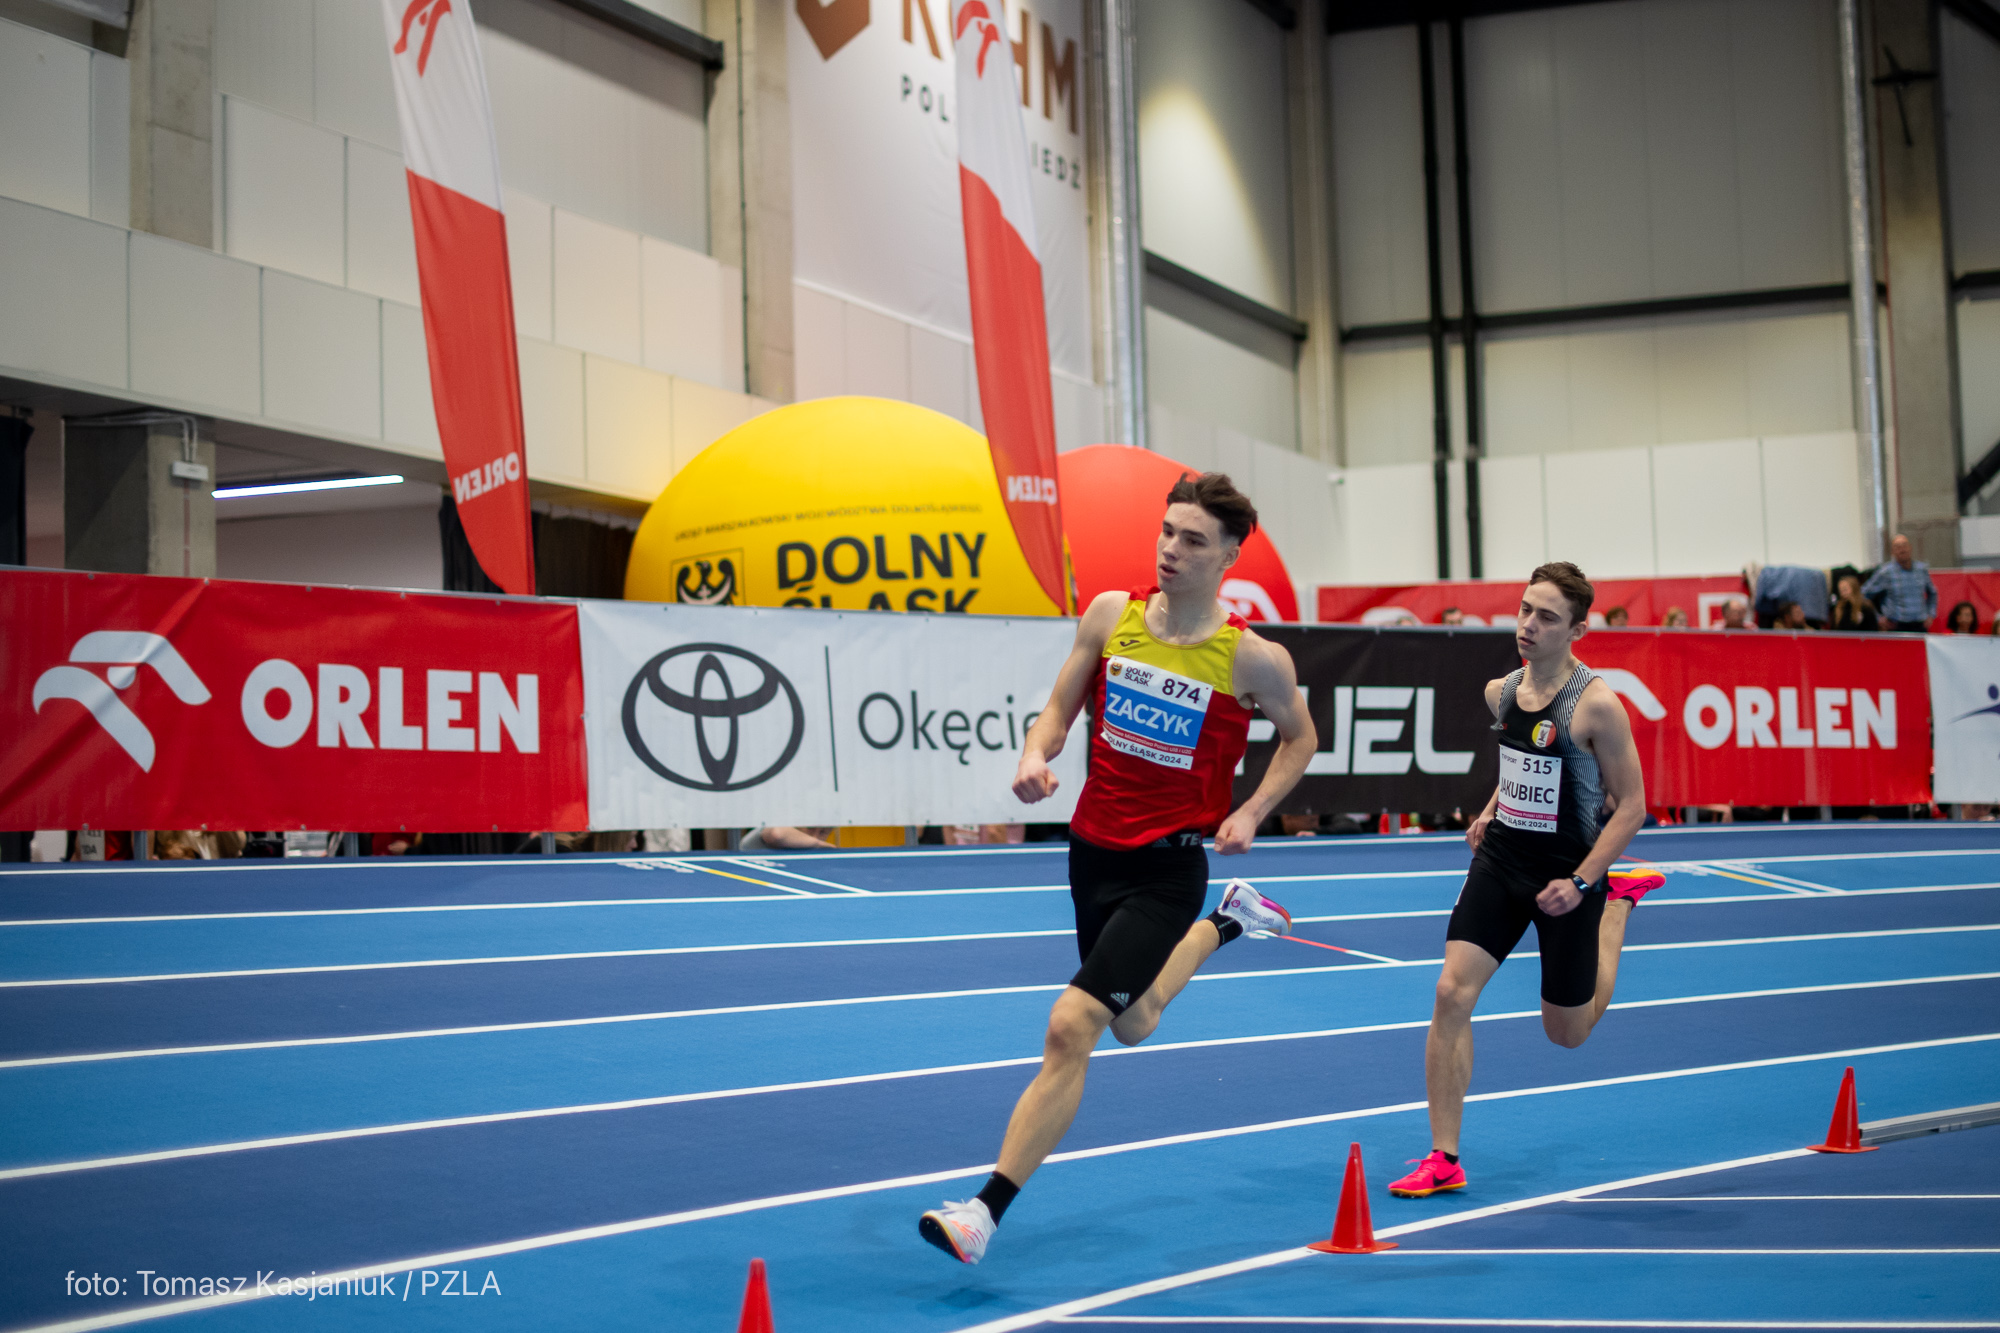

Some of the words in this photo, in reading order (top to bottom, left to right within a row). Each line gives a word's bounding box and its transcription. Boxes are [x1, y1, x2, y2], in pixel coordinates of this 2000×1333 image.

[902, 74, 950, 123] POL
[777, 532, 987, 590] DOLNY
[1124, 672, 1150, 687] ŚLĄSK
[1126, 666, 1154, 680] DOLNY
[1162, 678, 1201, 704] 874
[241, 658, 540, 754] ORLEN
[1106, 692, 1193, 737] ZACZYK
[1683, 684, 1897, 750] ORLEN
[1129, 744, 1157, 759] ŚLĄSK
[1158, 754, 1182, 764] 2024
[1522, 757, 1553, 775] 515
[1500, 777, 1555, 804] JAKUBIEC
[1528, 820, 1548, 829] 2024
